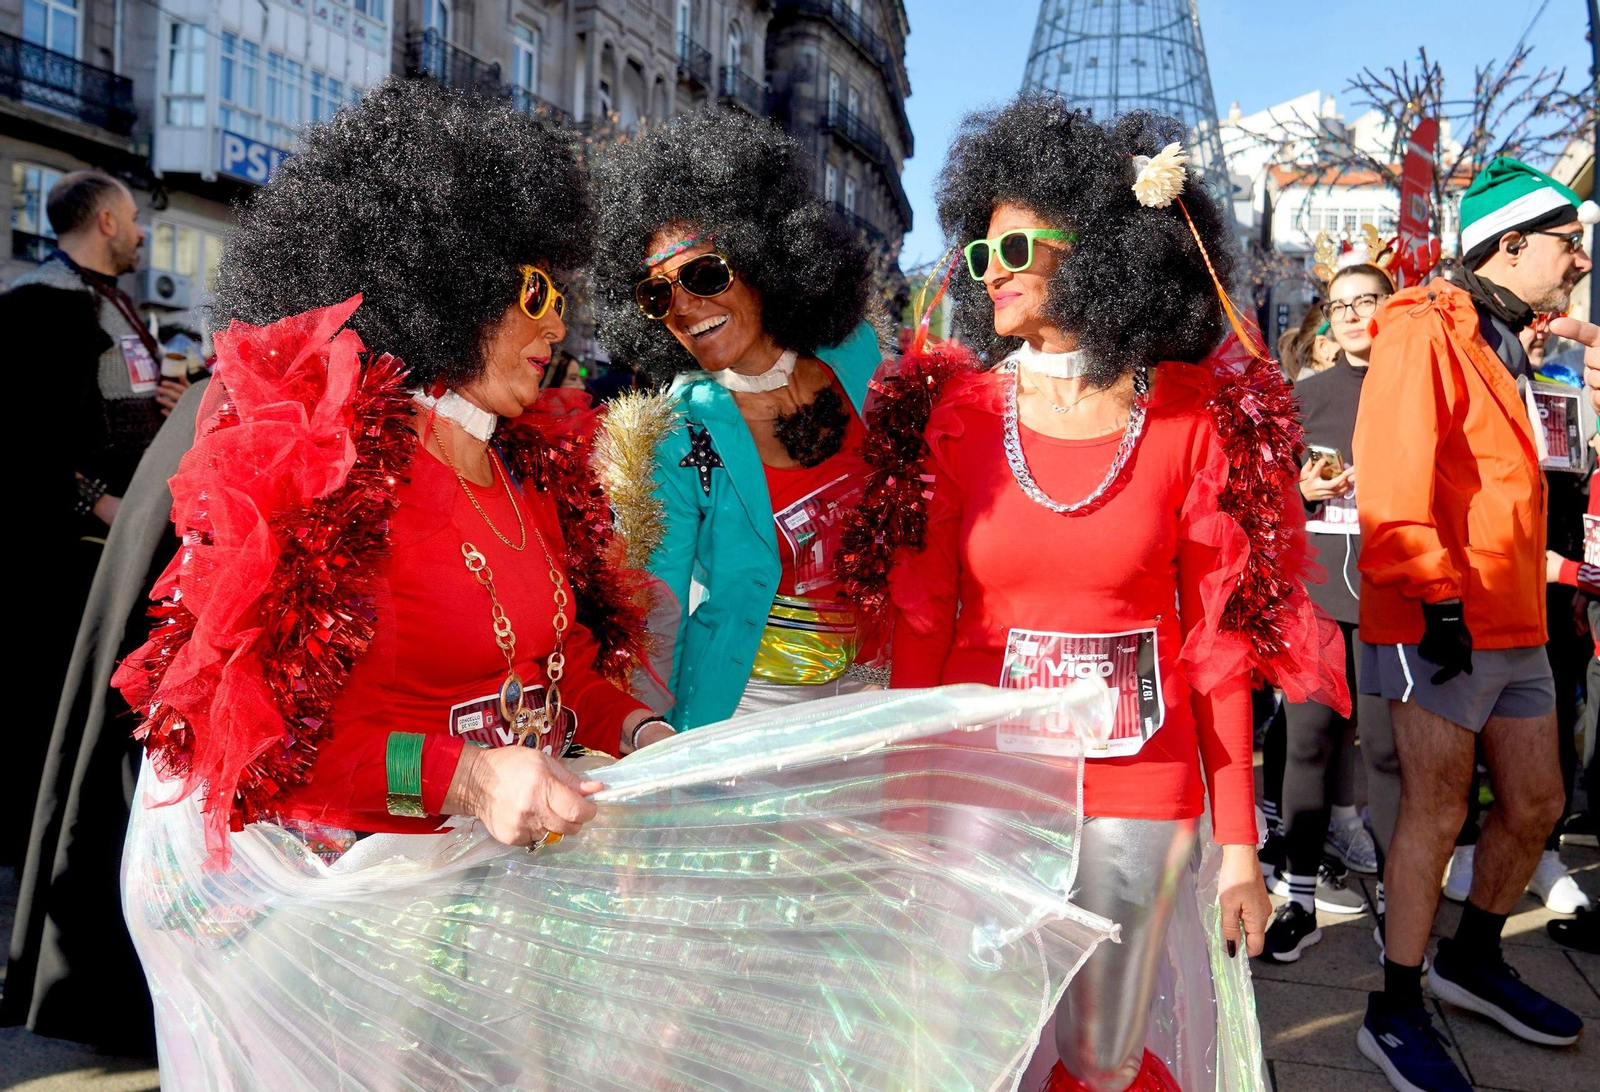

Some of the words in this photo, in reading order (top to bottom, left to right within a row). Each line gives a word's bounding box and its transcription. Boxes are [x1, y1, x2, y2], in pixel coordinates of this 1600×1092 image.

[1142, 678, 1154, 701] 1877
[459, 715, 481, 725] CONCELLO
[468, 721, 479, 729] VIGO
